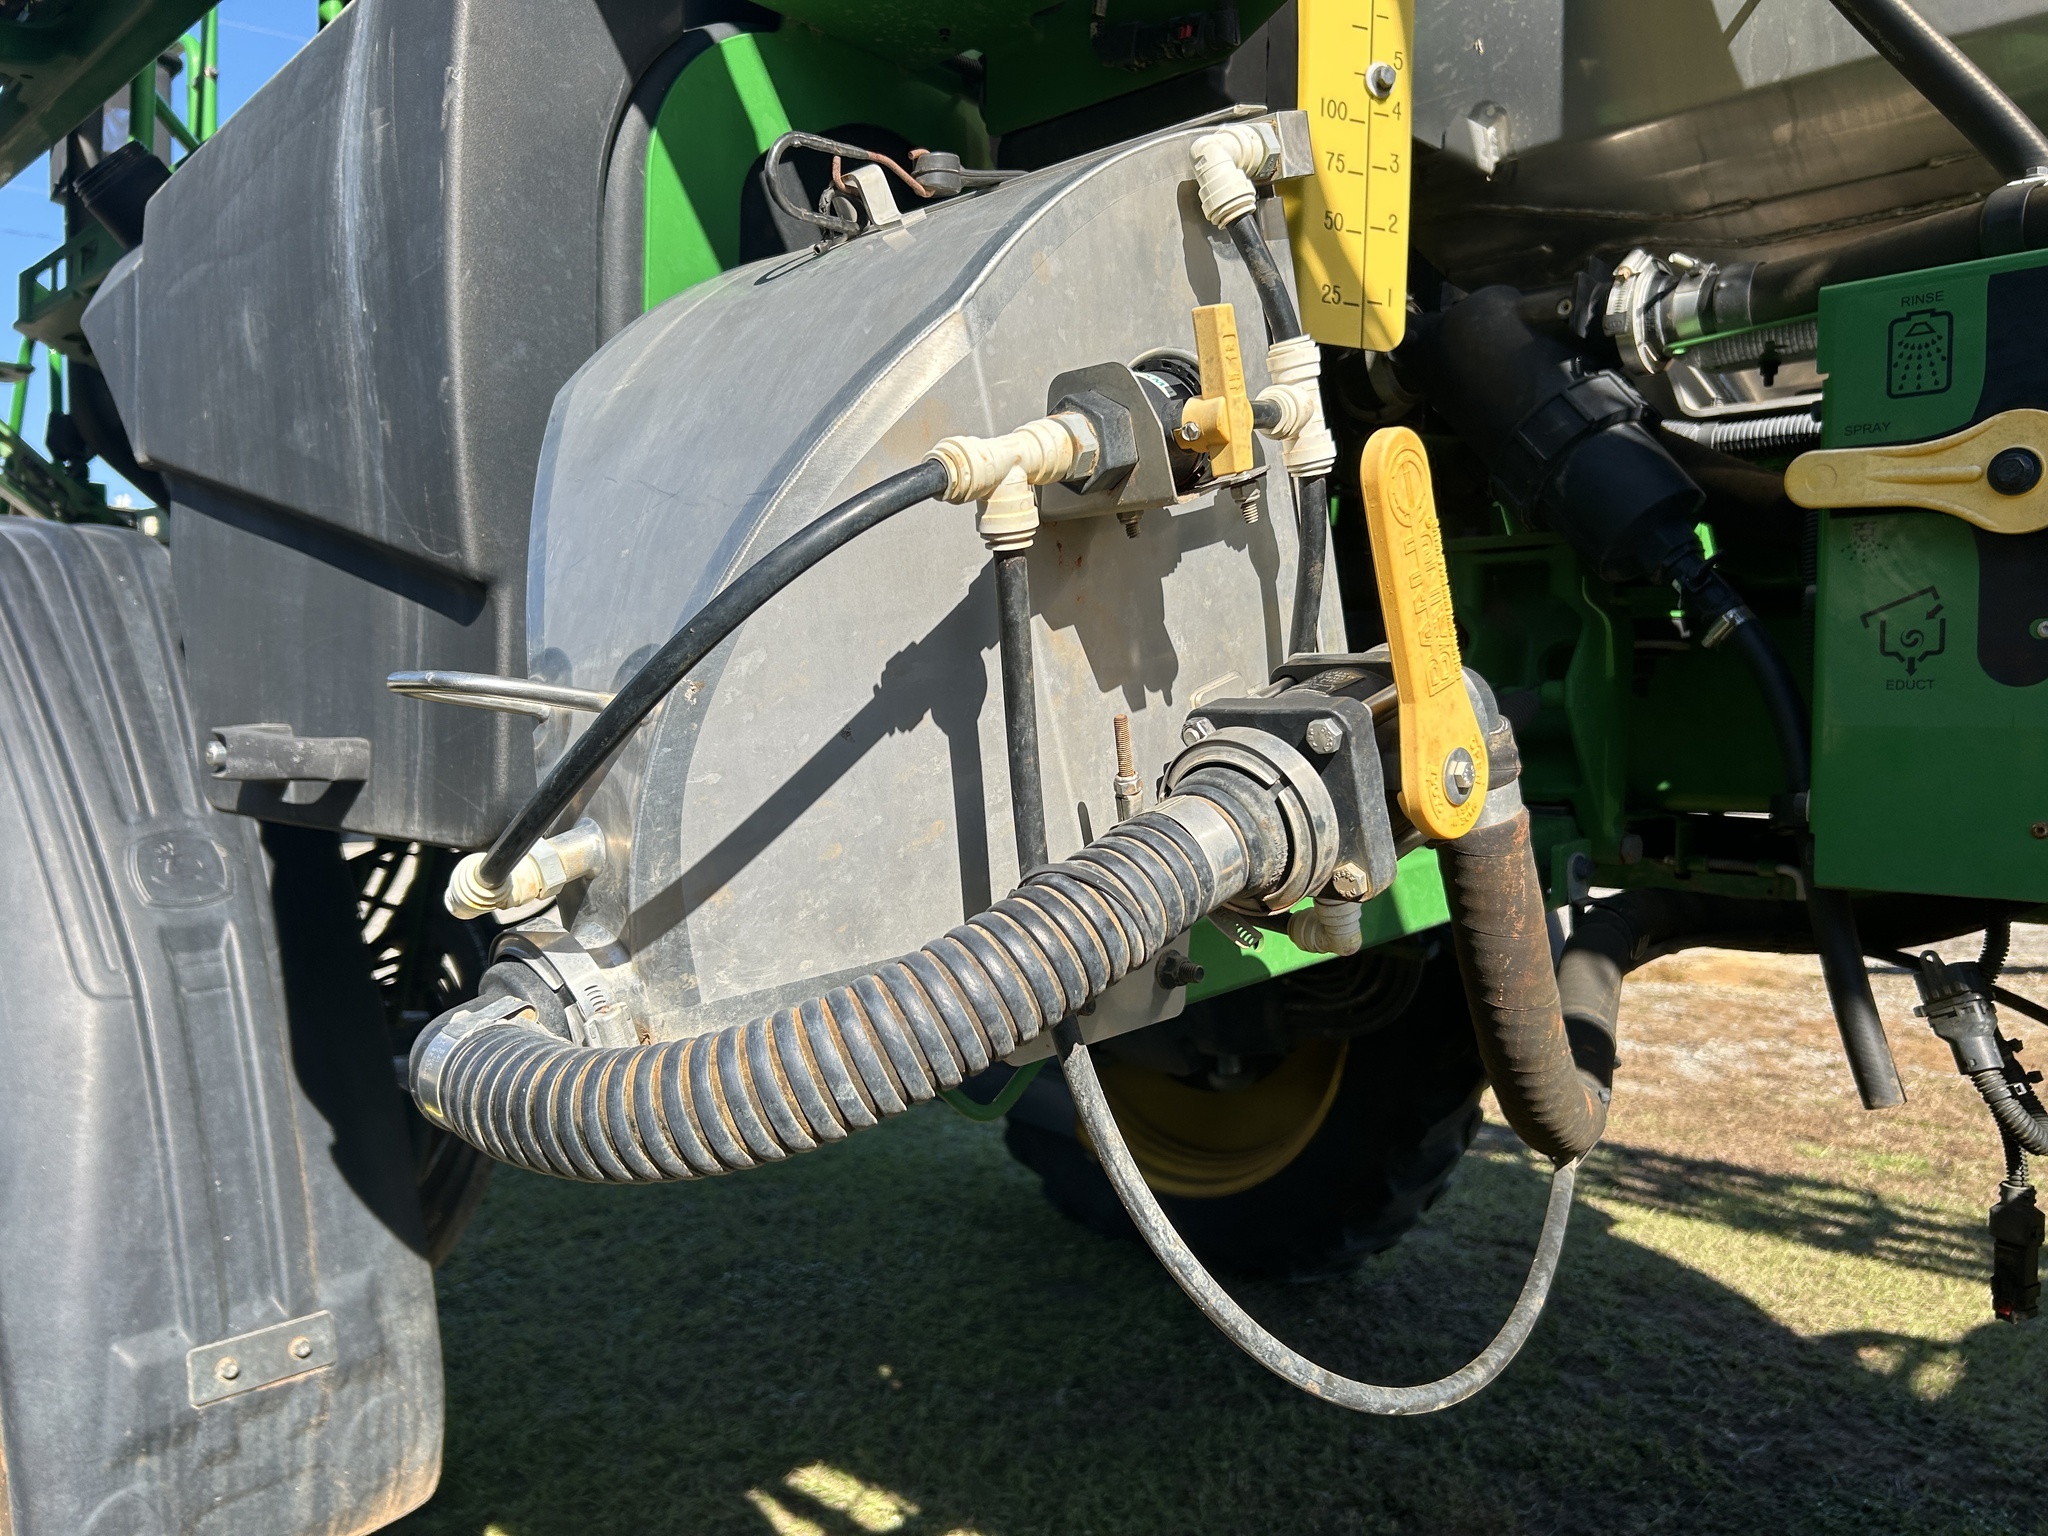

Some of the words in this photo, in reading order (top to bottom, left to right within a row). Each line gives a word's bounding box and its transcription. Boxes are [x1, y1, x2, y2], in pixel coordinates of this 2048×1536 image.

[1393, 51, 1404, 71] 5
[1320, 97, 1348, 121] 100
[1392, 101, 1402, 121] 4
[1325, 151, 1346, 173] 75
[1389, 153, 1400, 174] 3
[1323, 210, 1344, 232] 50
[1388, 213, 1398, 234] 2
[1321, 284, 1342, 305] 25
[1387, 288, 1392, 308] 1
[1901, 290, 1944, 307] RINSE
[1844, 421, 1892, 437] SPRAY
[1885, 679, 1935, 691] EDUCT
